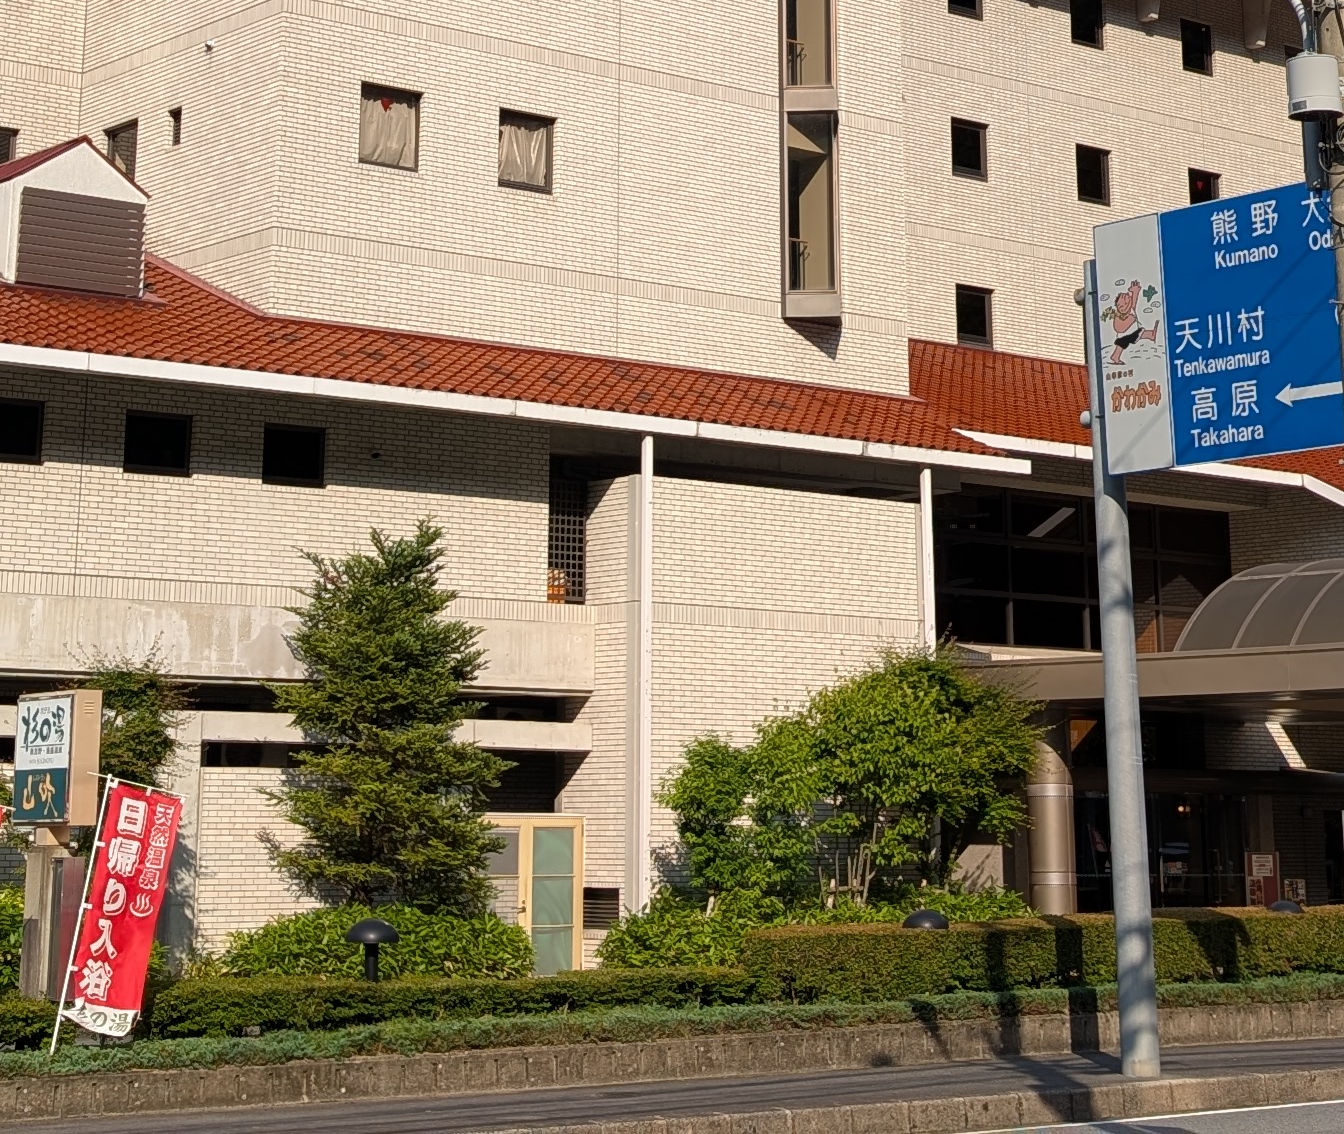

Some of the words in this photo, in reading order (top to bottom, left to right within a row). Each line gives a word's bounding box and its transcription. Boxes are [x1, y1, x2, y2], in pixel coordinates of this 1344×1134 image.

[1210, 200, 1279, 246] 熊野
[1214, 243, 1279, 269] Kumano
[1174, 306, 1265, 353] 天川村
[1174, 350, 1270, 377] Tenkawamura
[1111, 380, 1162, 413] かわかみ
[1190, 380, 1260, 423] 高原
[1190, 424, 1264, 448] Takahara
[21, 705, 65, 752] 杉の湯
[22, 772, 58, 817] 山吹
[78, 797, 148, 1001] 日帰り入浴
